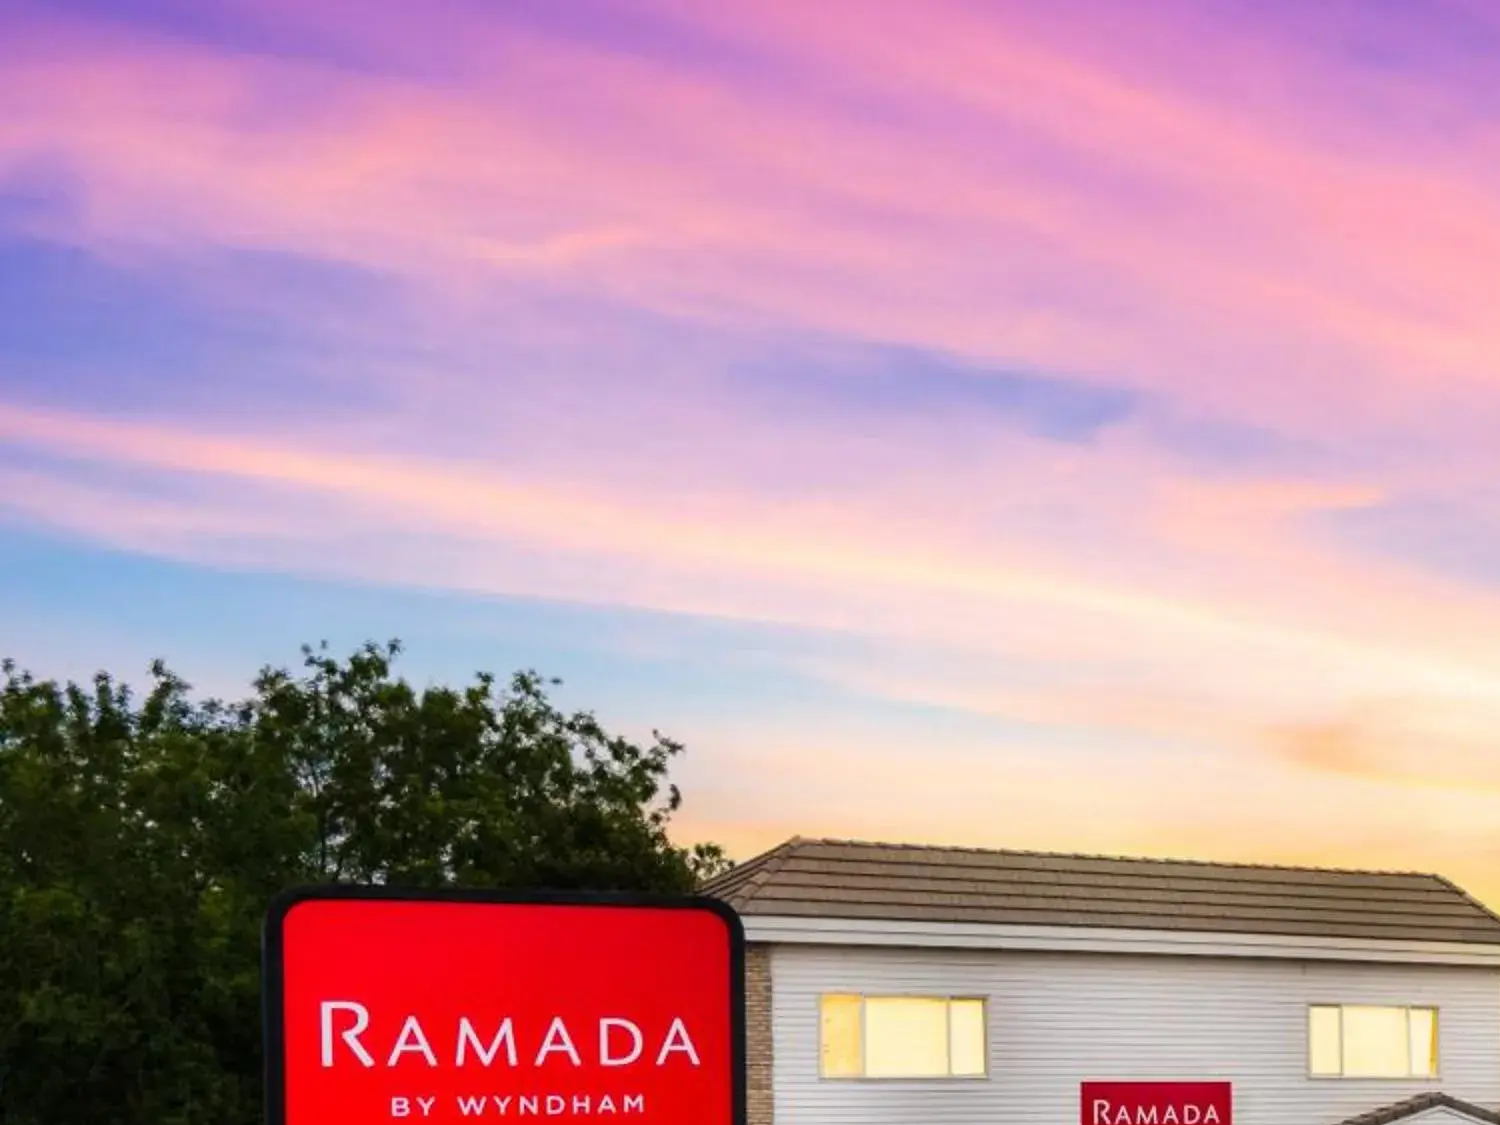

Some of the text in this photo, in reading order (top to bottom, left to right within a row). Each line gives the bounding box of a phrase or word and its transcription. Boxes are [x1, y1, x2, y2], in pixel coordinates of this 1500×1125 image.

[319, 1000, 700, 1068] RAMADA
[390, 1094, 644, 1117] BY WYNDHAM
